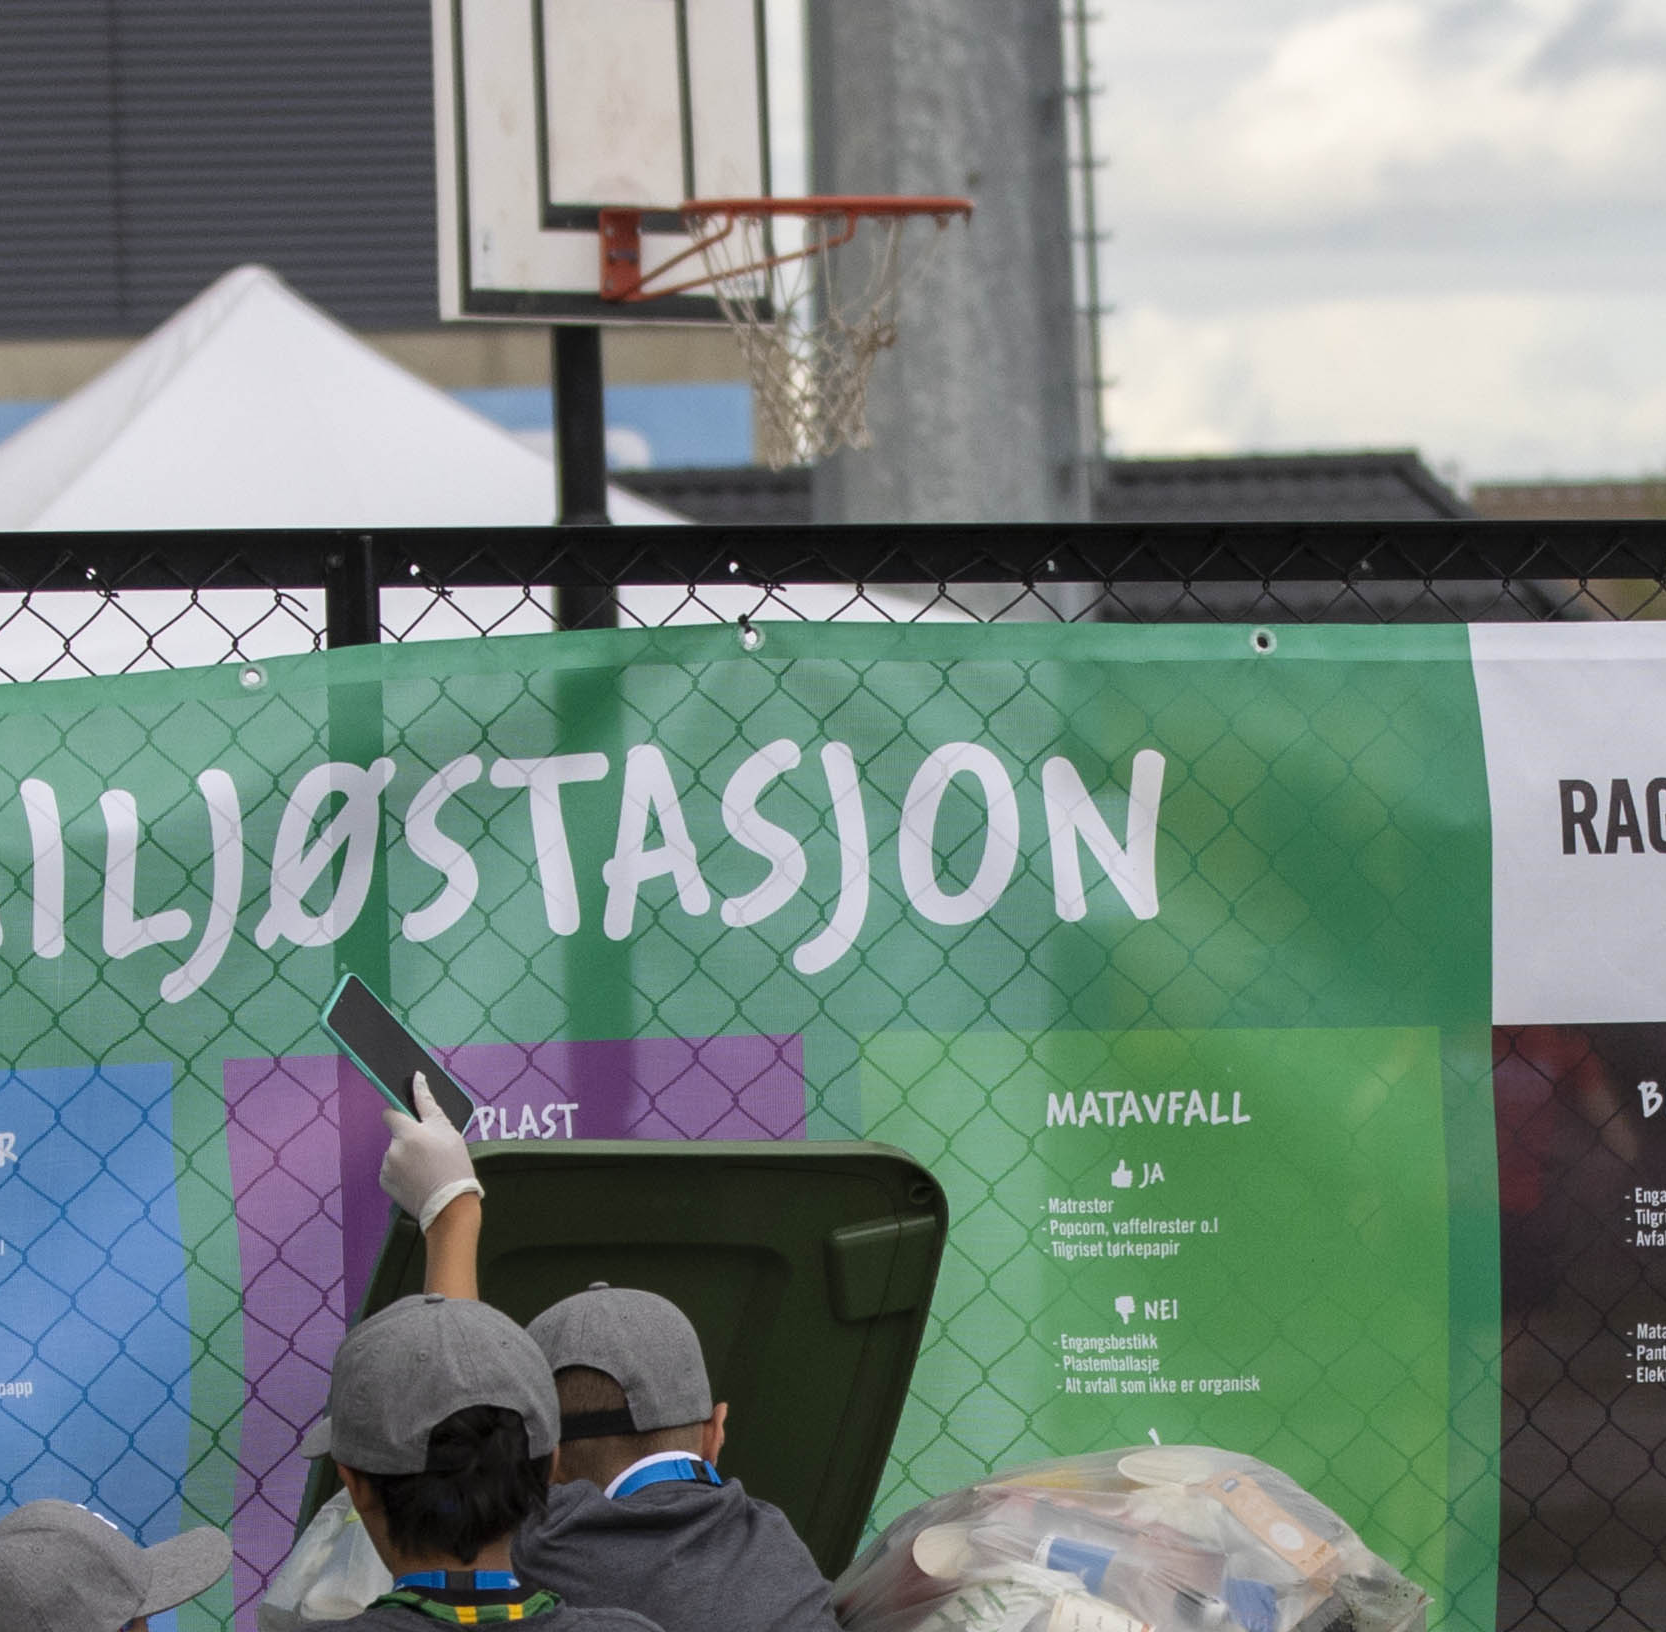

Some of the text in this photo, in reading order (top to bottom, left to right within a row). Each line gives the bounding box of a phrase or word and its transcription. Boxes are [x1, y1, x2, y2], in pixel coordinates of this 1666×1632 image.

[1046, 1089, 1251, 1128] MATAVFALL
[475, 1102, 579, 1141] PLAST
[1138, 1162, 1165, 1189] JA
[1048, 1198, 1114, 1214] Matrester
[1113, 1218, 1195, 1235] vaffelrester
[1051, 1240, 1180, 1261] Tilgriset tørkepapir
[1144, 1299, 1178, 1320] NEI
[1060, 1334, 1158, 1353] Engangsbestikk
[1063, 1355, 1159, 1375] Plastemballasje
[1065, 1376, 1261, 1396] Alt avfall som ikke er organisk
